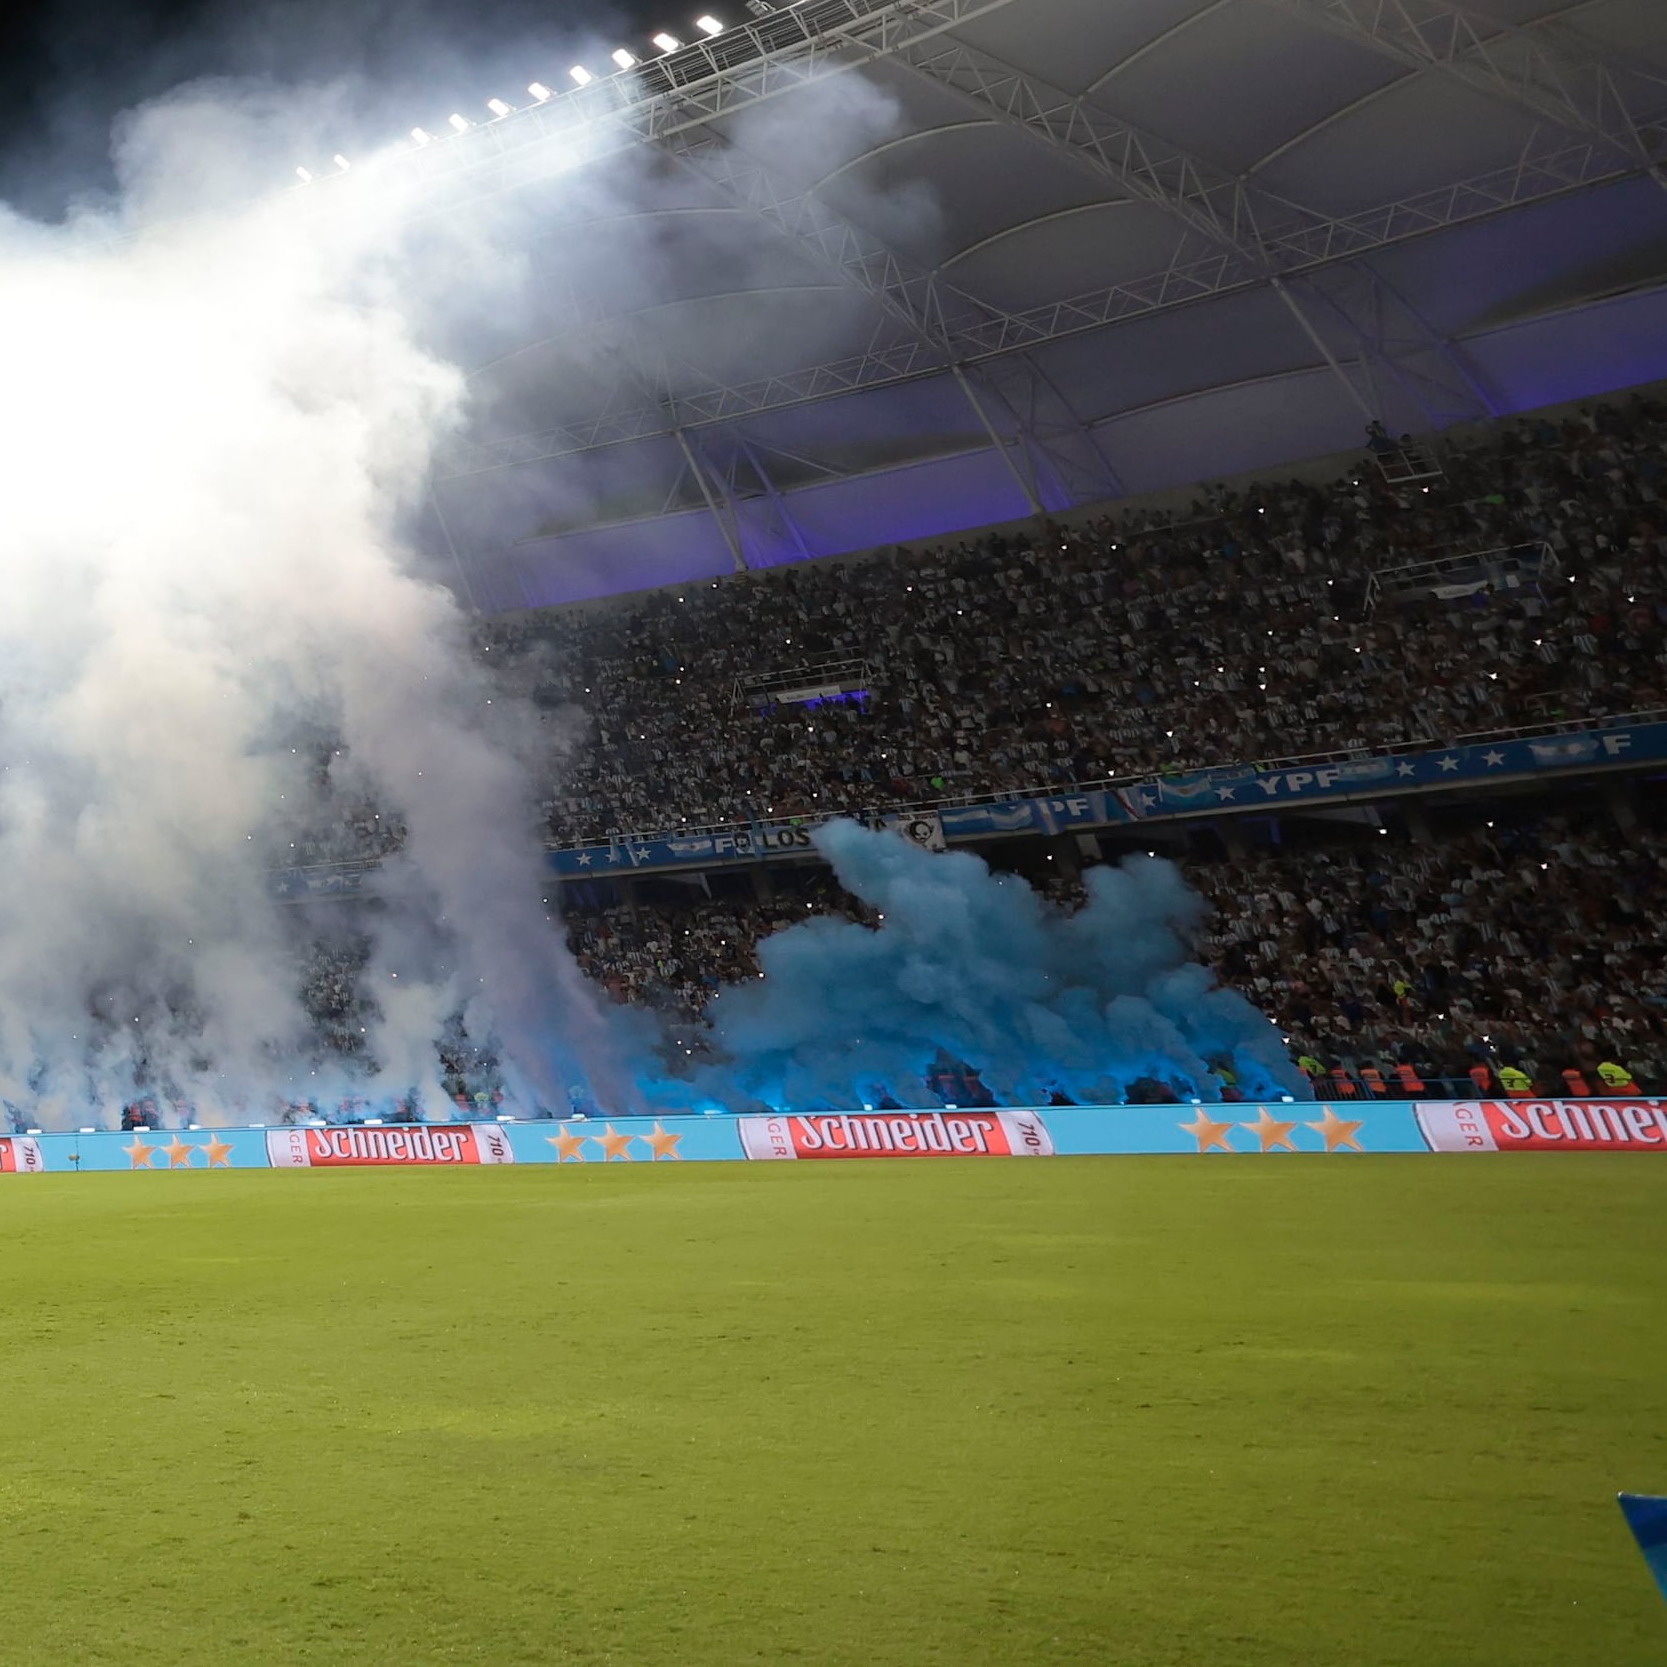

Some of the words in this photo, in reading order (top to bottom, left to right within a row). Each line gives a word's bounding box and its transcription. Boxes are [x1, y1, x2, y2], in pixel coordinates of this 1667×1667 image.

[1257, 769, 1340, 796] YPF
[801, 1113, 993, 1153] Schneider
[1501, 1100, 1667, 1144] Schnei
[315, 1126, 468, 1161] Schneider
